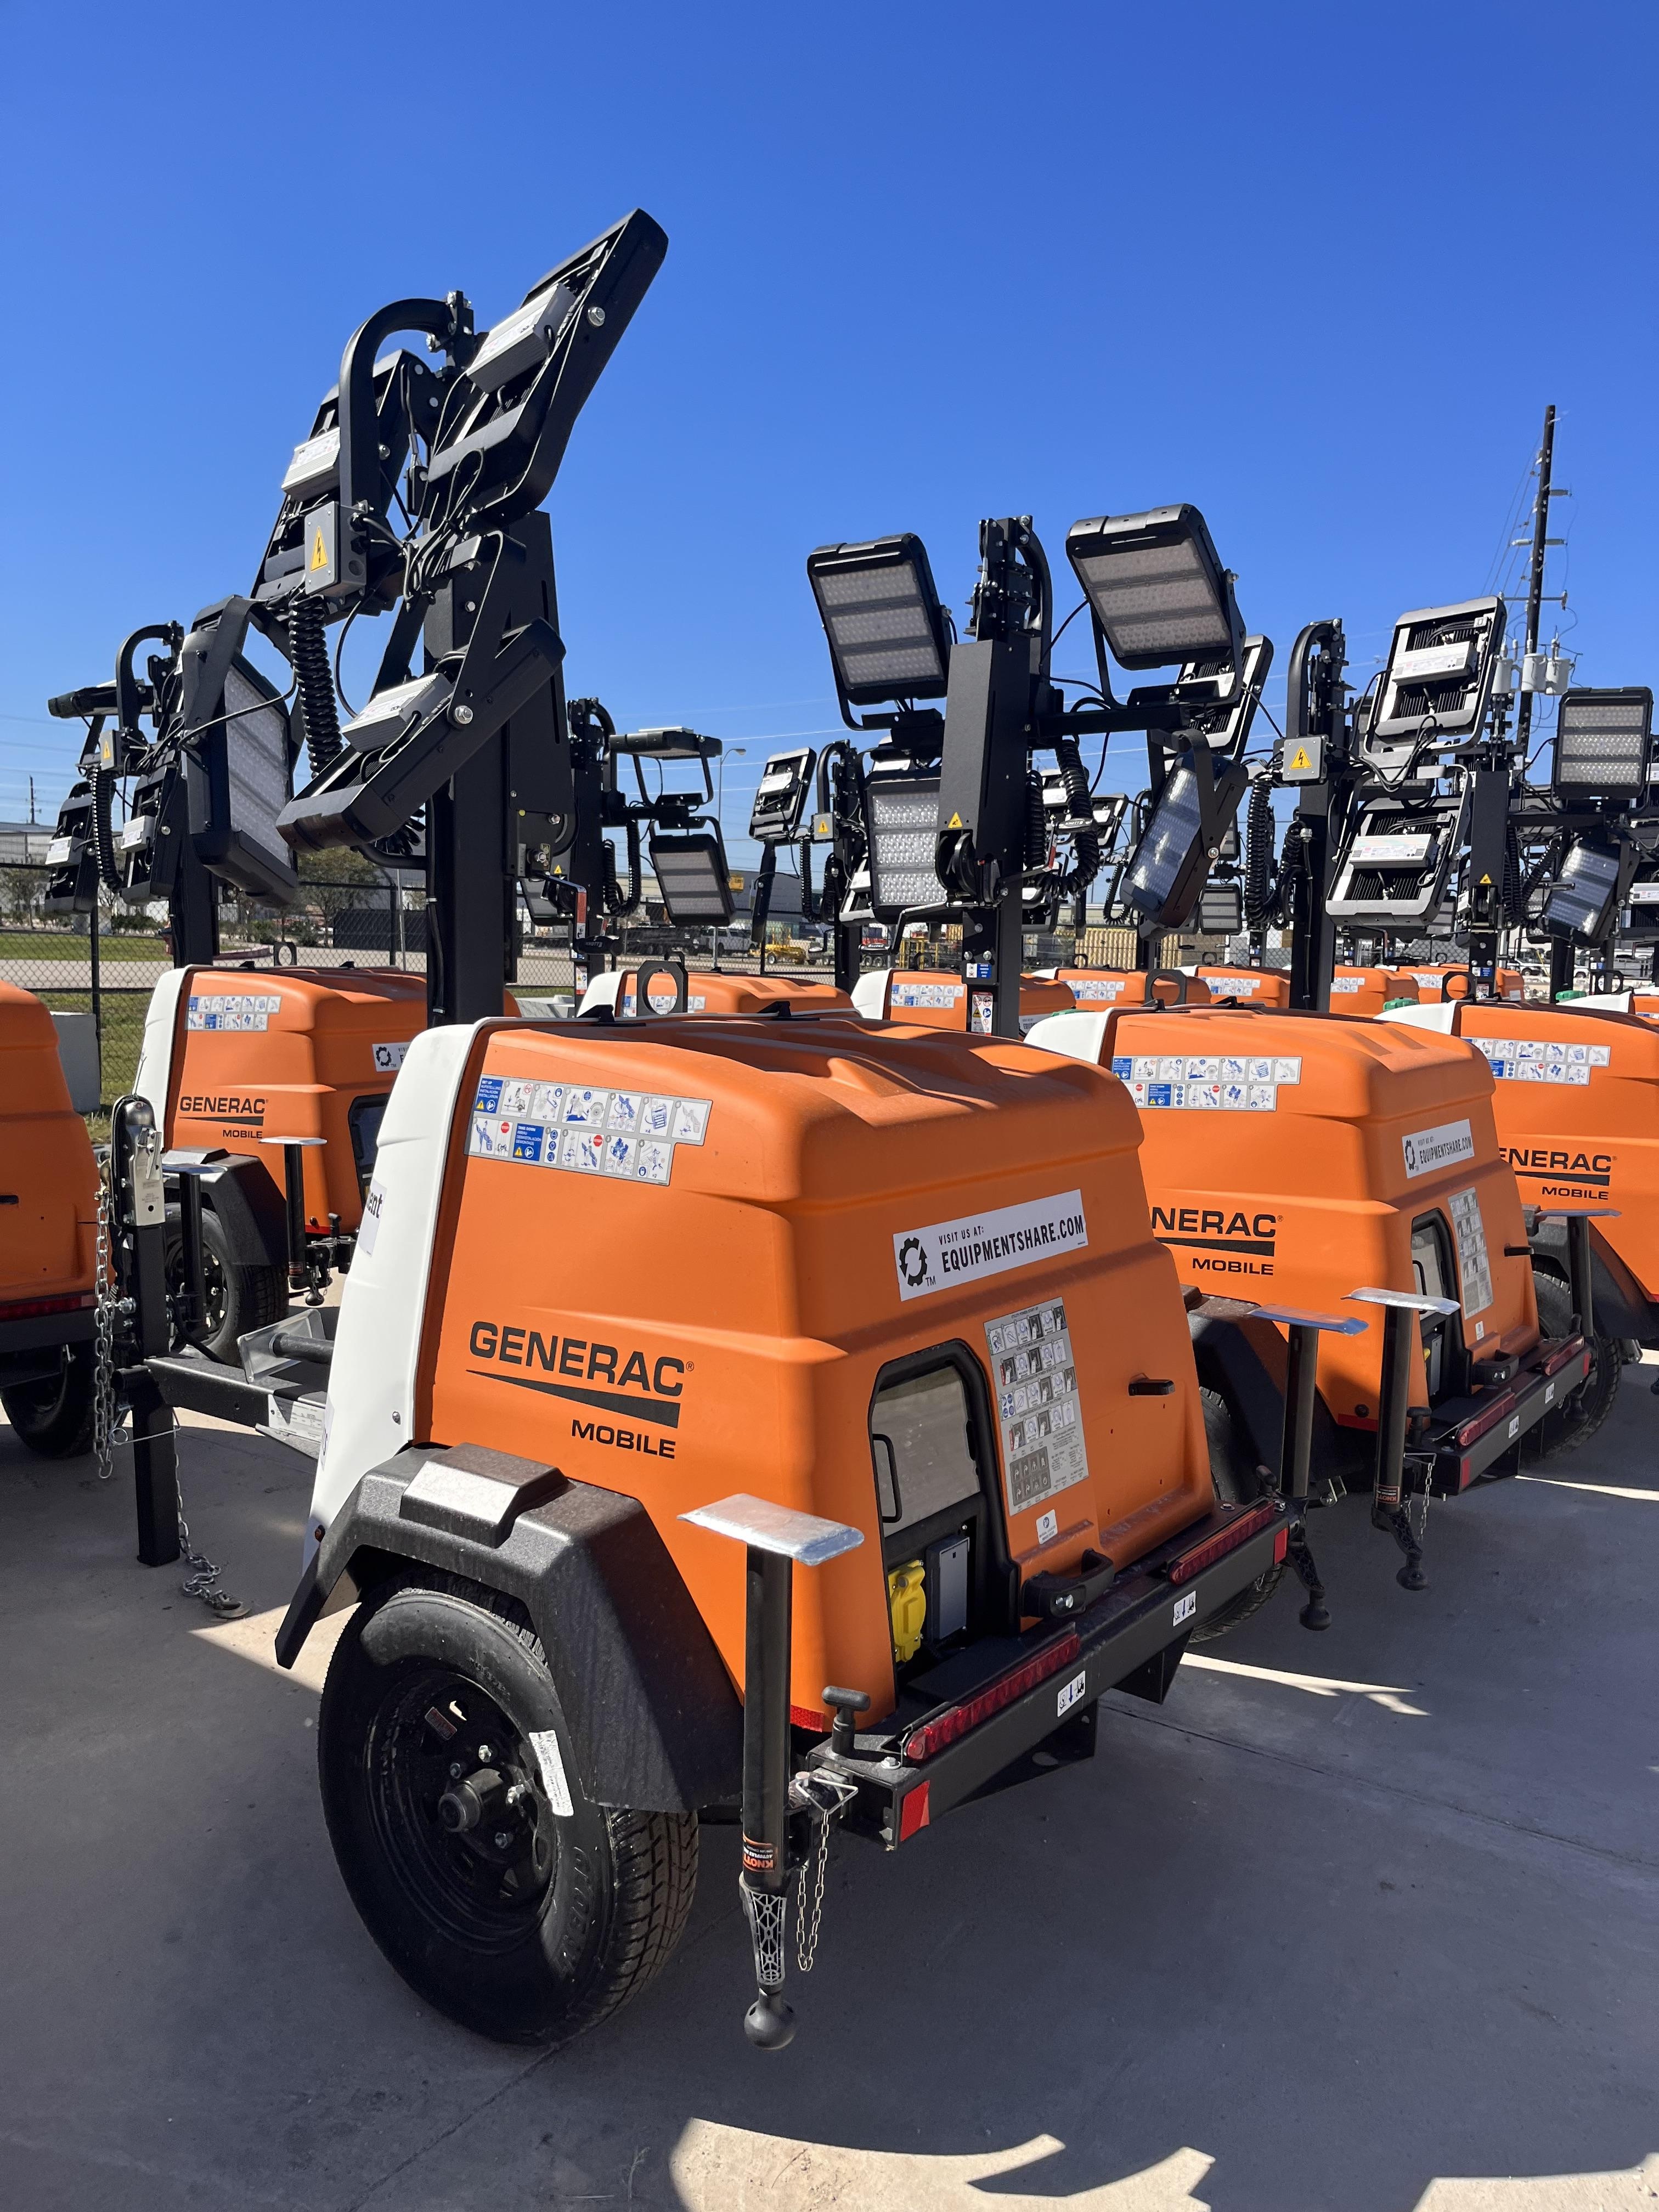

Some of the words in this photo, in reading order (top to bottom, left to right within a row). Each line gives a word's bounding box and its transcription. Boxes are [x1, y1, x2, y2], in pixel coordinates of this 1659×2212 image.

[223, 1130, 263, 1139] MOBILE
[1419, 1136, 1472, 1164] EQUIPMENTSHARE.COM
[1499, 1148, 1611, 1172] NERAC
[1542, 1187, 1609, 1200] MOBILE
[368, 1193, 383, 1218] ent
[939, 1231, 958, 1245] VISIT
[962, 1229, 970, 1240] US
[974, 1226, 984, 1237] AT:
[941, 1215, 1084, 1273] EQUIPMENTSHARE.COM
[1193, 1258, 1274, 1276] MOBILE
[925, 1276, 936, 1286] TM
[571, 1419, 676, 1459] MOBILE
[743, 1853, 774, 1869] KNOTT
